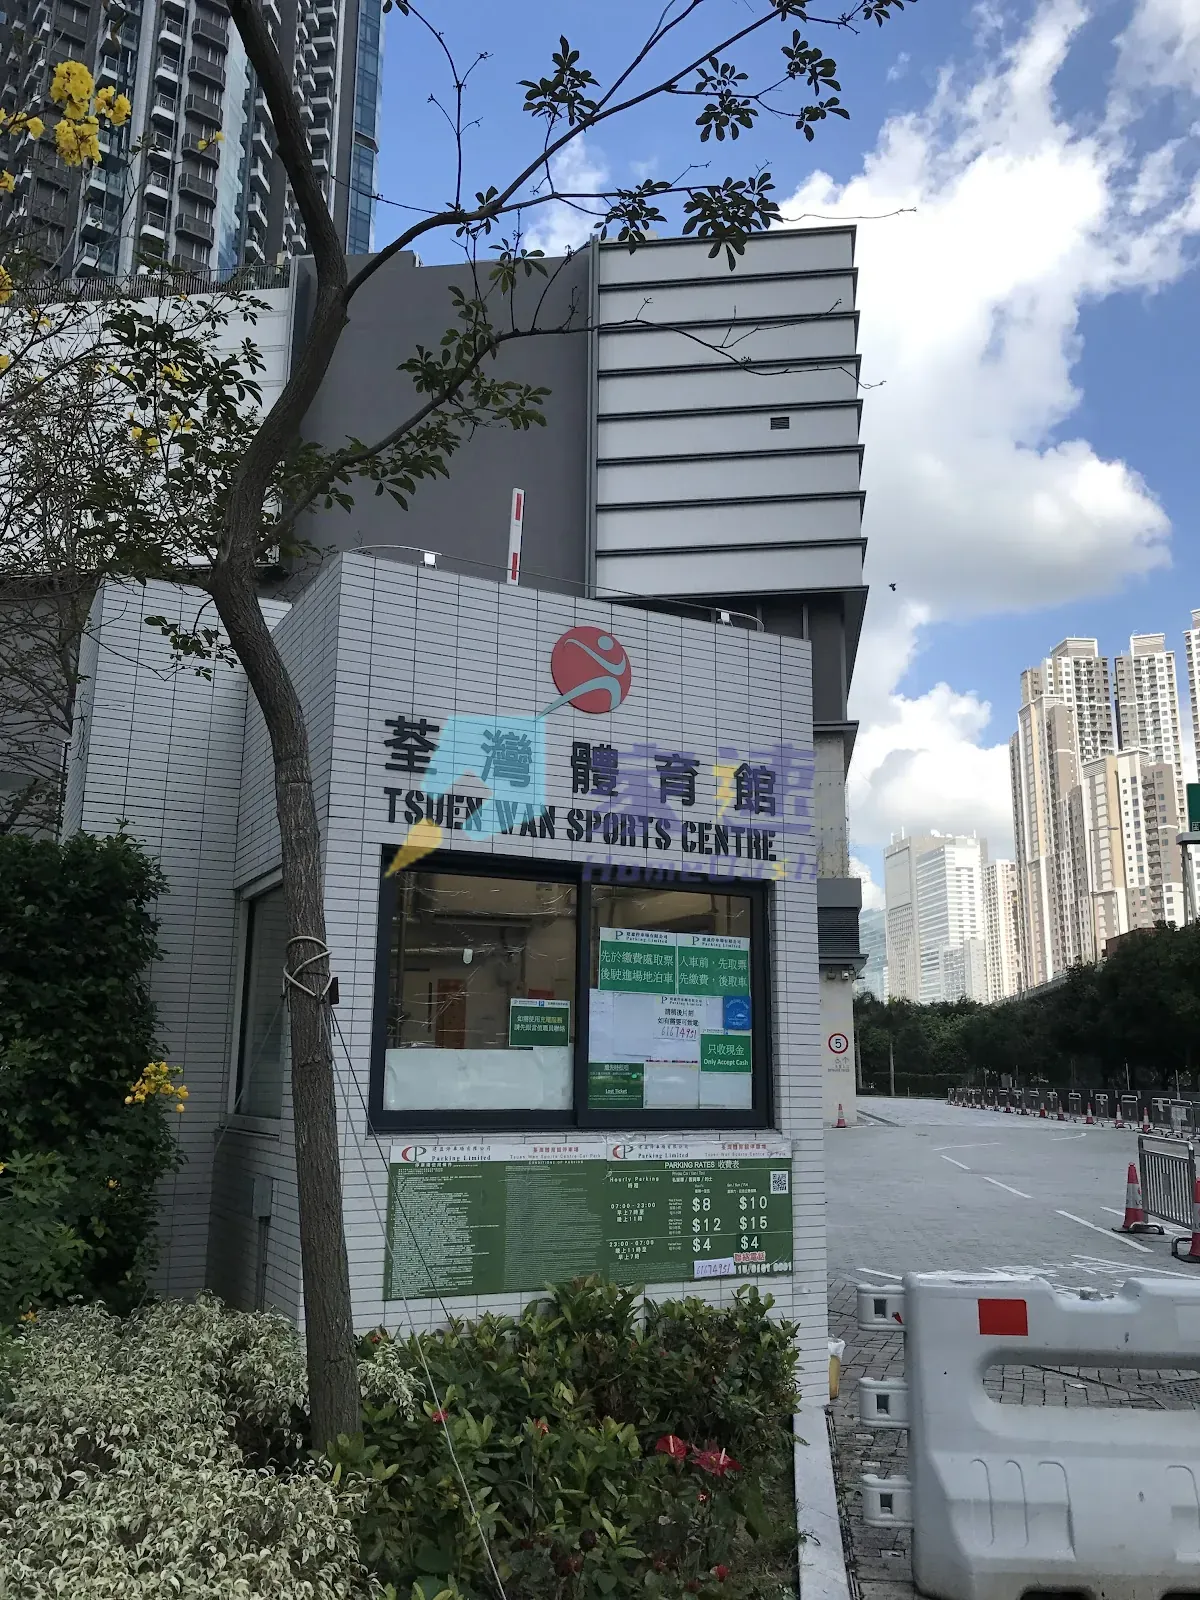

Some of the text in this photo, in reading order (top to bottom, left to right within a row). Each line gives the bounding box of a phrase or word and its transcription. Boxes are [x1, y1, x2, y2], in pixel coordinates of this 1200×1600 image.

[384, 715, 776, 816] 荃灣體育館
[384, 786, 777, 861] TSUEN WAN SPORTS CENTRE
[708, 1044, 745, 1056] 只收現金
[835, 1038, 842, 1049] 5
[703, 1058, 717, 1066] Only
[718, 1058, 736, 1067] Accept
[664, 1161, 694, 1169] PARKING
[692, 1197, 711, 1213] $8
[739, 1195, 768, 1210] $10
[692, 1217, 721, 1233] $12
[739, 1216, 768, 1231] $15
[692, 1237, 711, 1253] $4
[740, 1235, 759, 1250] $4
